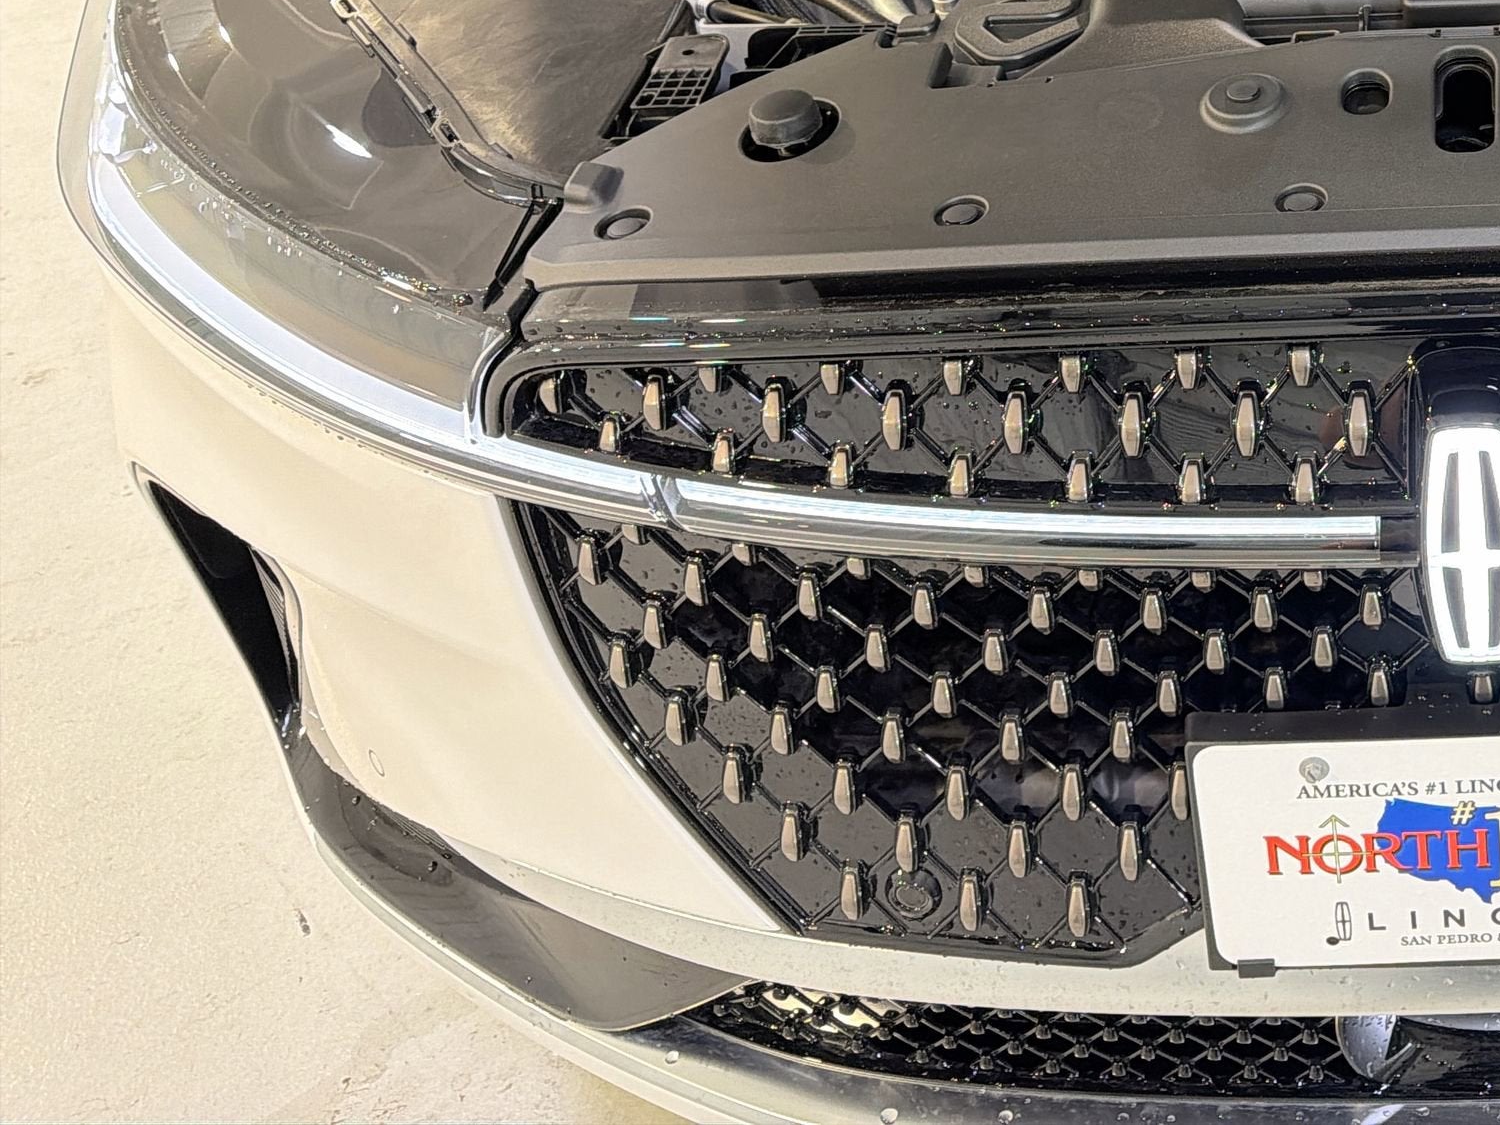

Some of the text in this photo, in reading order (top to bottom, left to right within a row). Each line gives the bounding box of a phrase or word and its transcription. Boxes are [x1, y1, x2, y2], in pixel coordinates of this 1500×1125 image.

[1425, 782, 1448, 795] #1
[1263, 827, 1491, 875] NORTH
[1400, 935, 1432, 946] SAN
[1437, 932, 1492, 944] PEDRO
